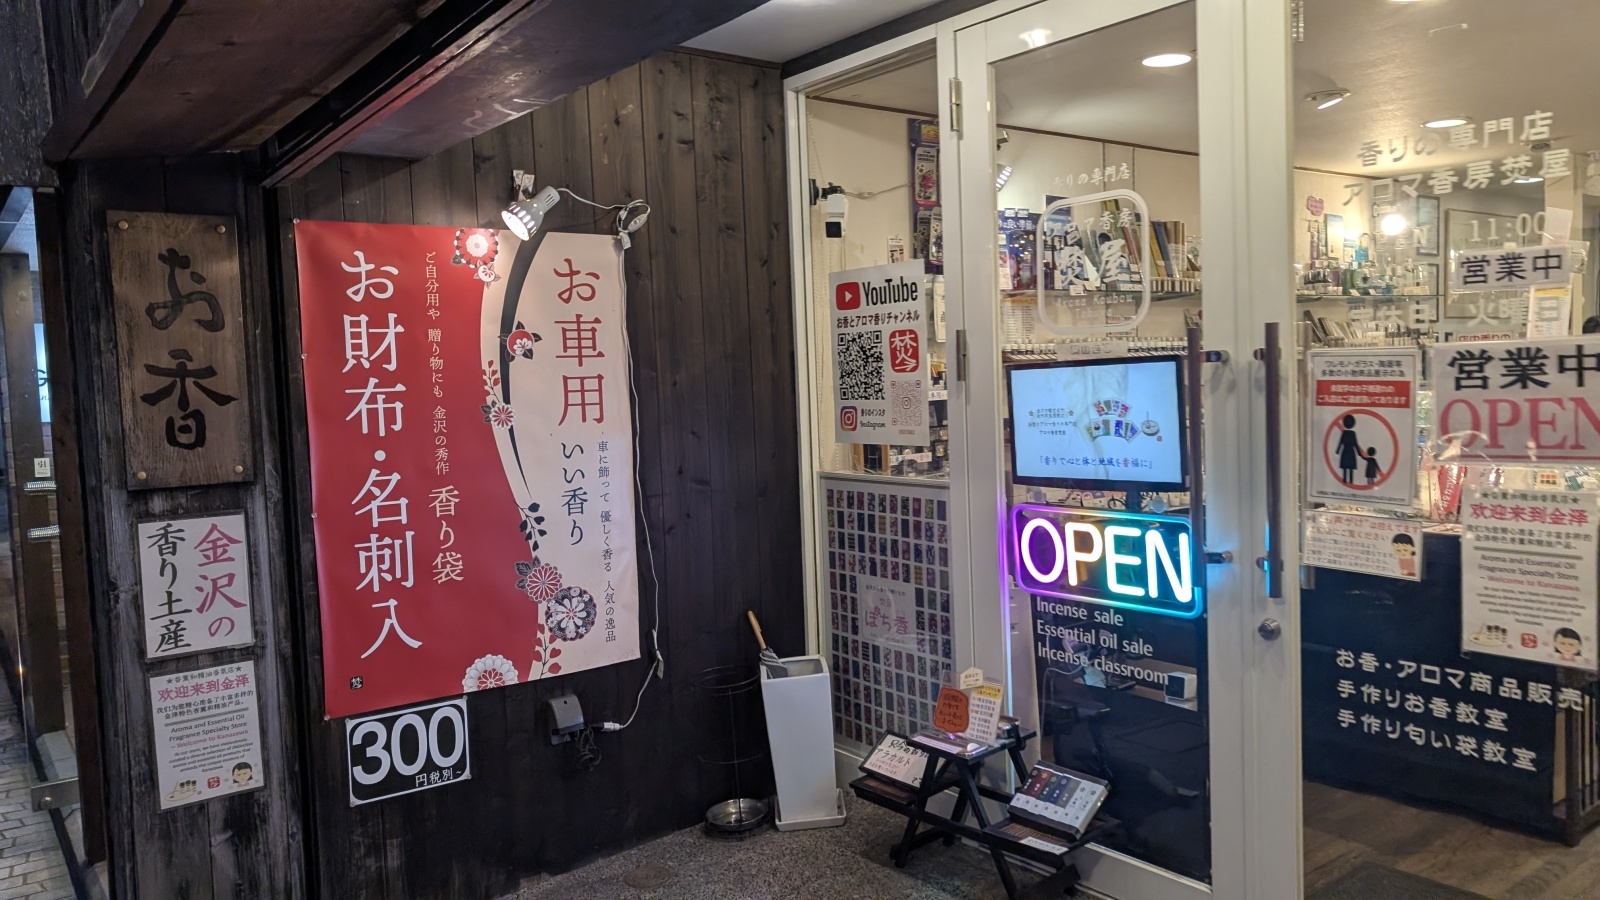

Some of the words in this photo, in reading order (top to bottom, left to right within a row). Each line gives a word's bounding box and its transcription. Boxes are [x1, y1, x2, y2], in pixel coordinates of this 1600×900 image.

[1358, 110, 1553, 167] 香りの専門店
[425, 252, 441, 320] ご自分用や
[862, 276, 918, 306] YouTube
[1461, 249, 1563, 286] 営業中
[140, 247, 239, 450] お香
[553, 258, 605, 426] お車用
[836, 309, 920, 329] お香とアロマ香りチャンネル
[427, 328, 444, 398] 贈り物にも
[1448, 344, 1600, 391] 営業中
[432, 406, 449, 475] 金沢の秀作
[1439, 397, 1600, 450] OPEN
[340, 250, 423, 659] お財布・名刺入
[597, 441, 611, 502] 車に飾って
[560, 442, 589, 546] いい香り
[1470, 502, 1589, 527] 欢迎来到金泽
[428, 485, 464, 584] 香り袋
[600, 510, 614, 573] 優しく香る
[1020, 517, 1193, 603] OPEN
[146, 522, 193, 653] 香り土産
[193, 522, 248, 638] 金沢の
[603, 581, 616, 642] 人気の逸品
[1037, 596, 1088, 620] Incense
[1094, 608, 1124, 627] sale
[1037, 619, 1095, 646] Essential
[1100, 632, 1118, 650] oil
[1122, 639, 1154, 657] sale
[157, 673, 250, 703] 欢迎来到金泽
[1037, 642, 1090, 667] Incense
[1094, 656, 1169, 686] classroom
[1335, 648, 1584, 712] お香・アロマ商品販売
[169, 732, 201, 742] Fragrance
[202, 724, 230, 737] Specialty
[231, 721, 248, 730] Store
[171, 725, 193, 734] Aroma
[194, 722, 206, 730] and
[207, 715, 235, 726] Essential
[1336, 679, 1509, 732] 手作りお香教室
[177, 738, 207, 749] Welcome
[352, 706, 464, 785] 300
[1336, 708, 1538, 772] 手作り匂い袋教室
